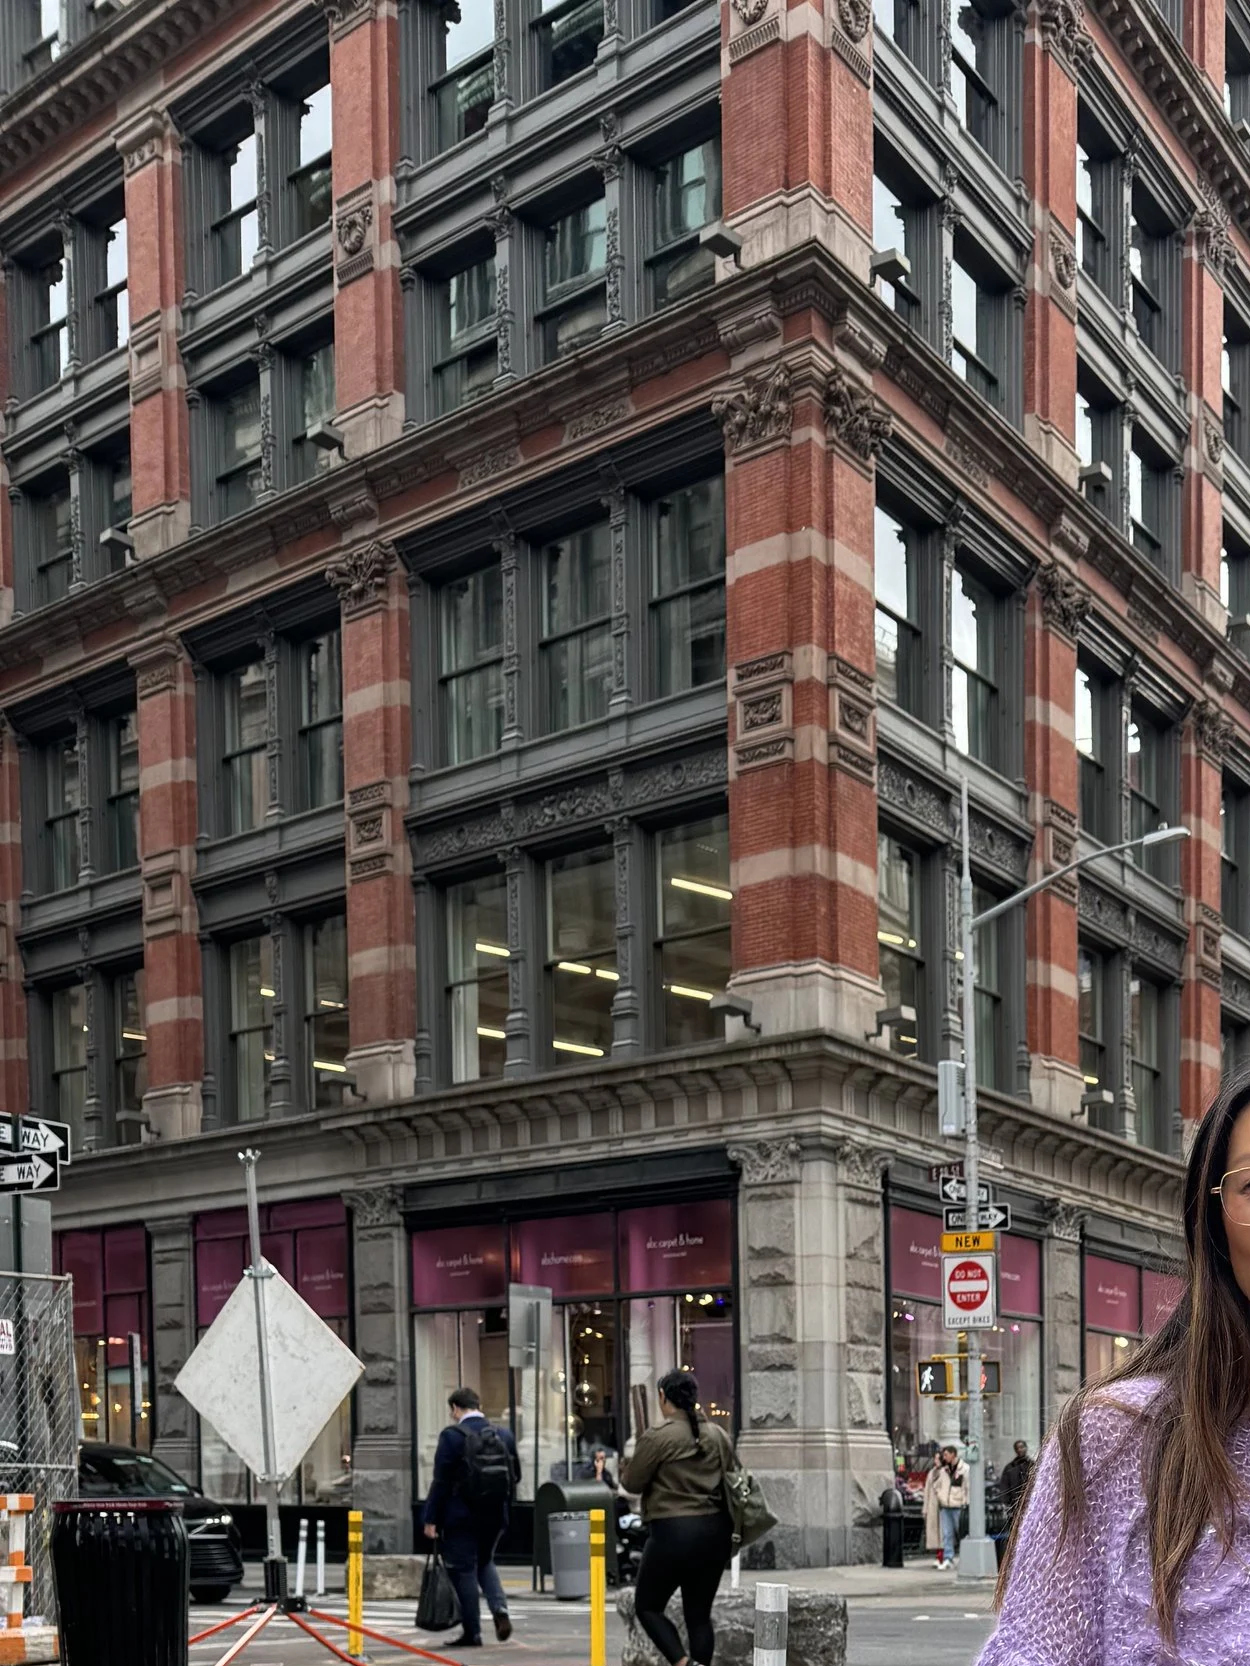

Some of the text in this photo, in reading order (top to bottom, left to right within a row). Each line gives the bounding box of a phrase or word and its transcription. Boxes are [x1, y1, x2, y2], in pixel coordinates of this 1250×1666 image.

[22, 1130, 49, 1148] WAY
[17, 1164, 41, 1180] WAY
[952, 1214, 963, 1224] ON
[686, 1232, 704, 1245] home
[955, 1235, 980, 1248] NEW
[955, 1269, 981, 1280] DO NOT
[957, 1293, 981, 1303] ENTER
[948, 1316, 990, 1326] EXCEPT BIKES
